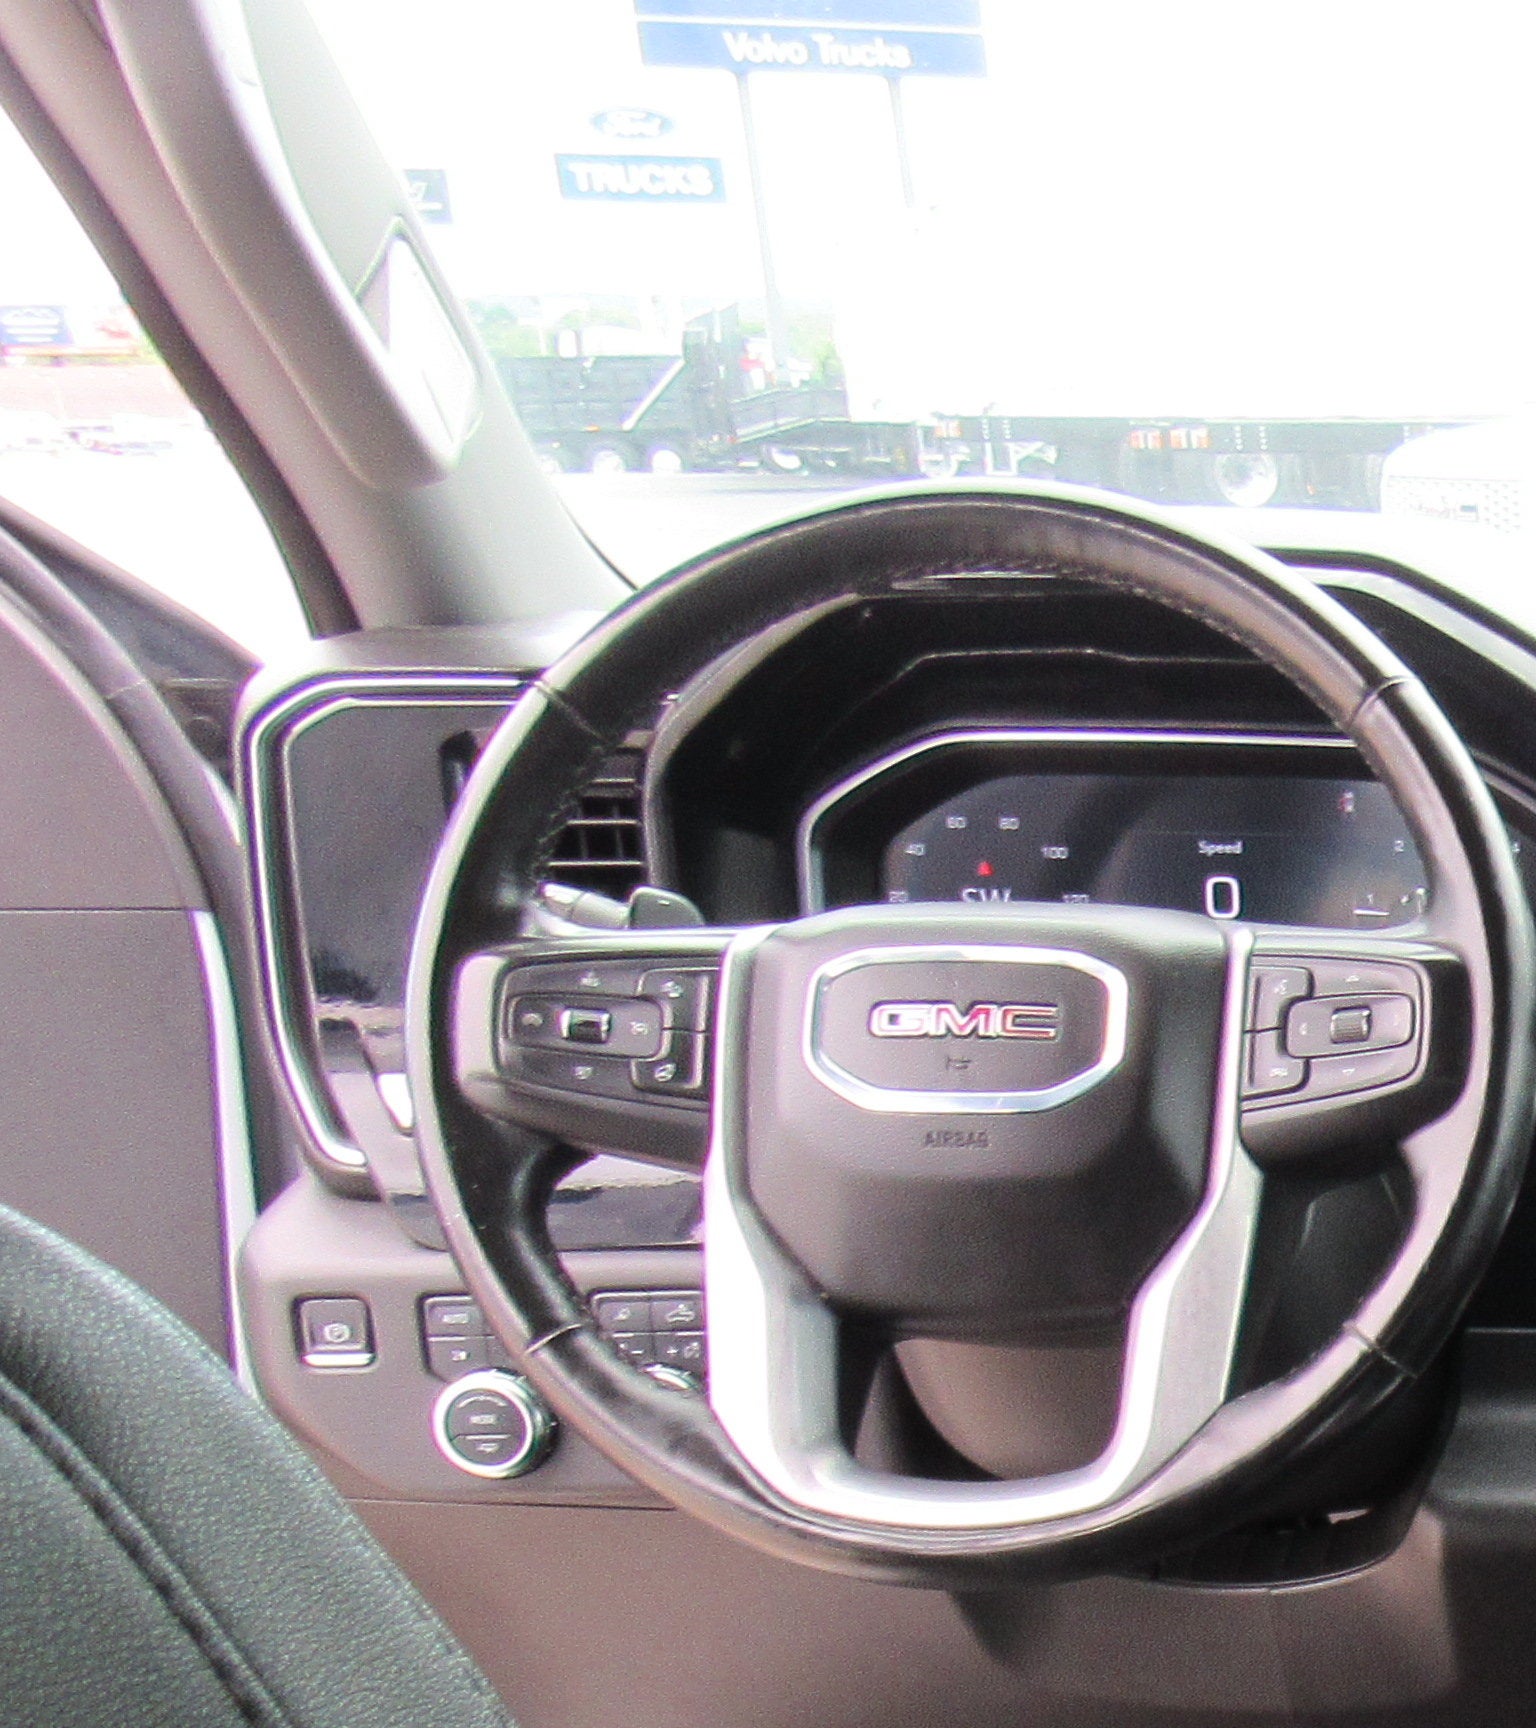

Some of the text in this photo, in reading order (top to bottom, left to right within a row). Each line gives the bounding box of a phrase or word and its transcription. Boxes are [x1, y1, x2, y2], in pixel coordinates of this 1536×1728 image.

[721, 30, 913, 69] Volvo Trucks
[566, 161, 715, 198] TRUCKS
[1199, 839, 1243, 857] Speed
[1204, 875, 1241, 920] 0
[870, 1000, 1059, 1041] GMC
